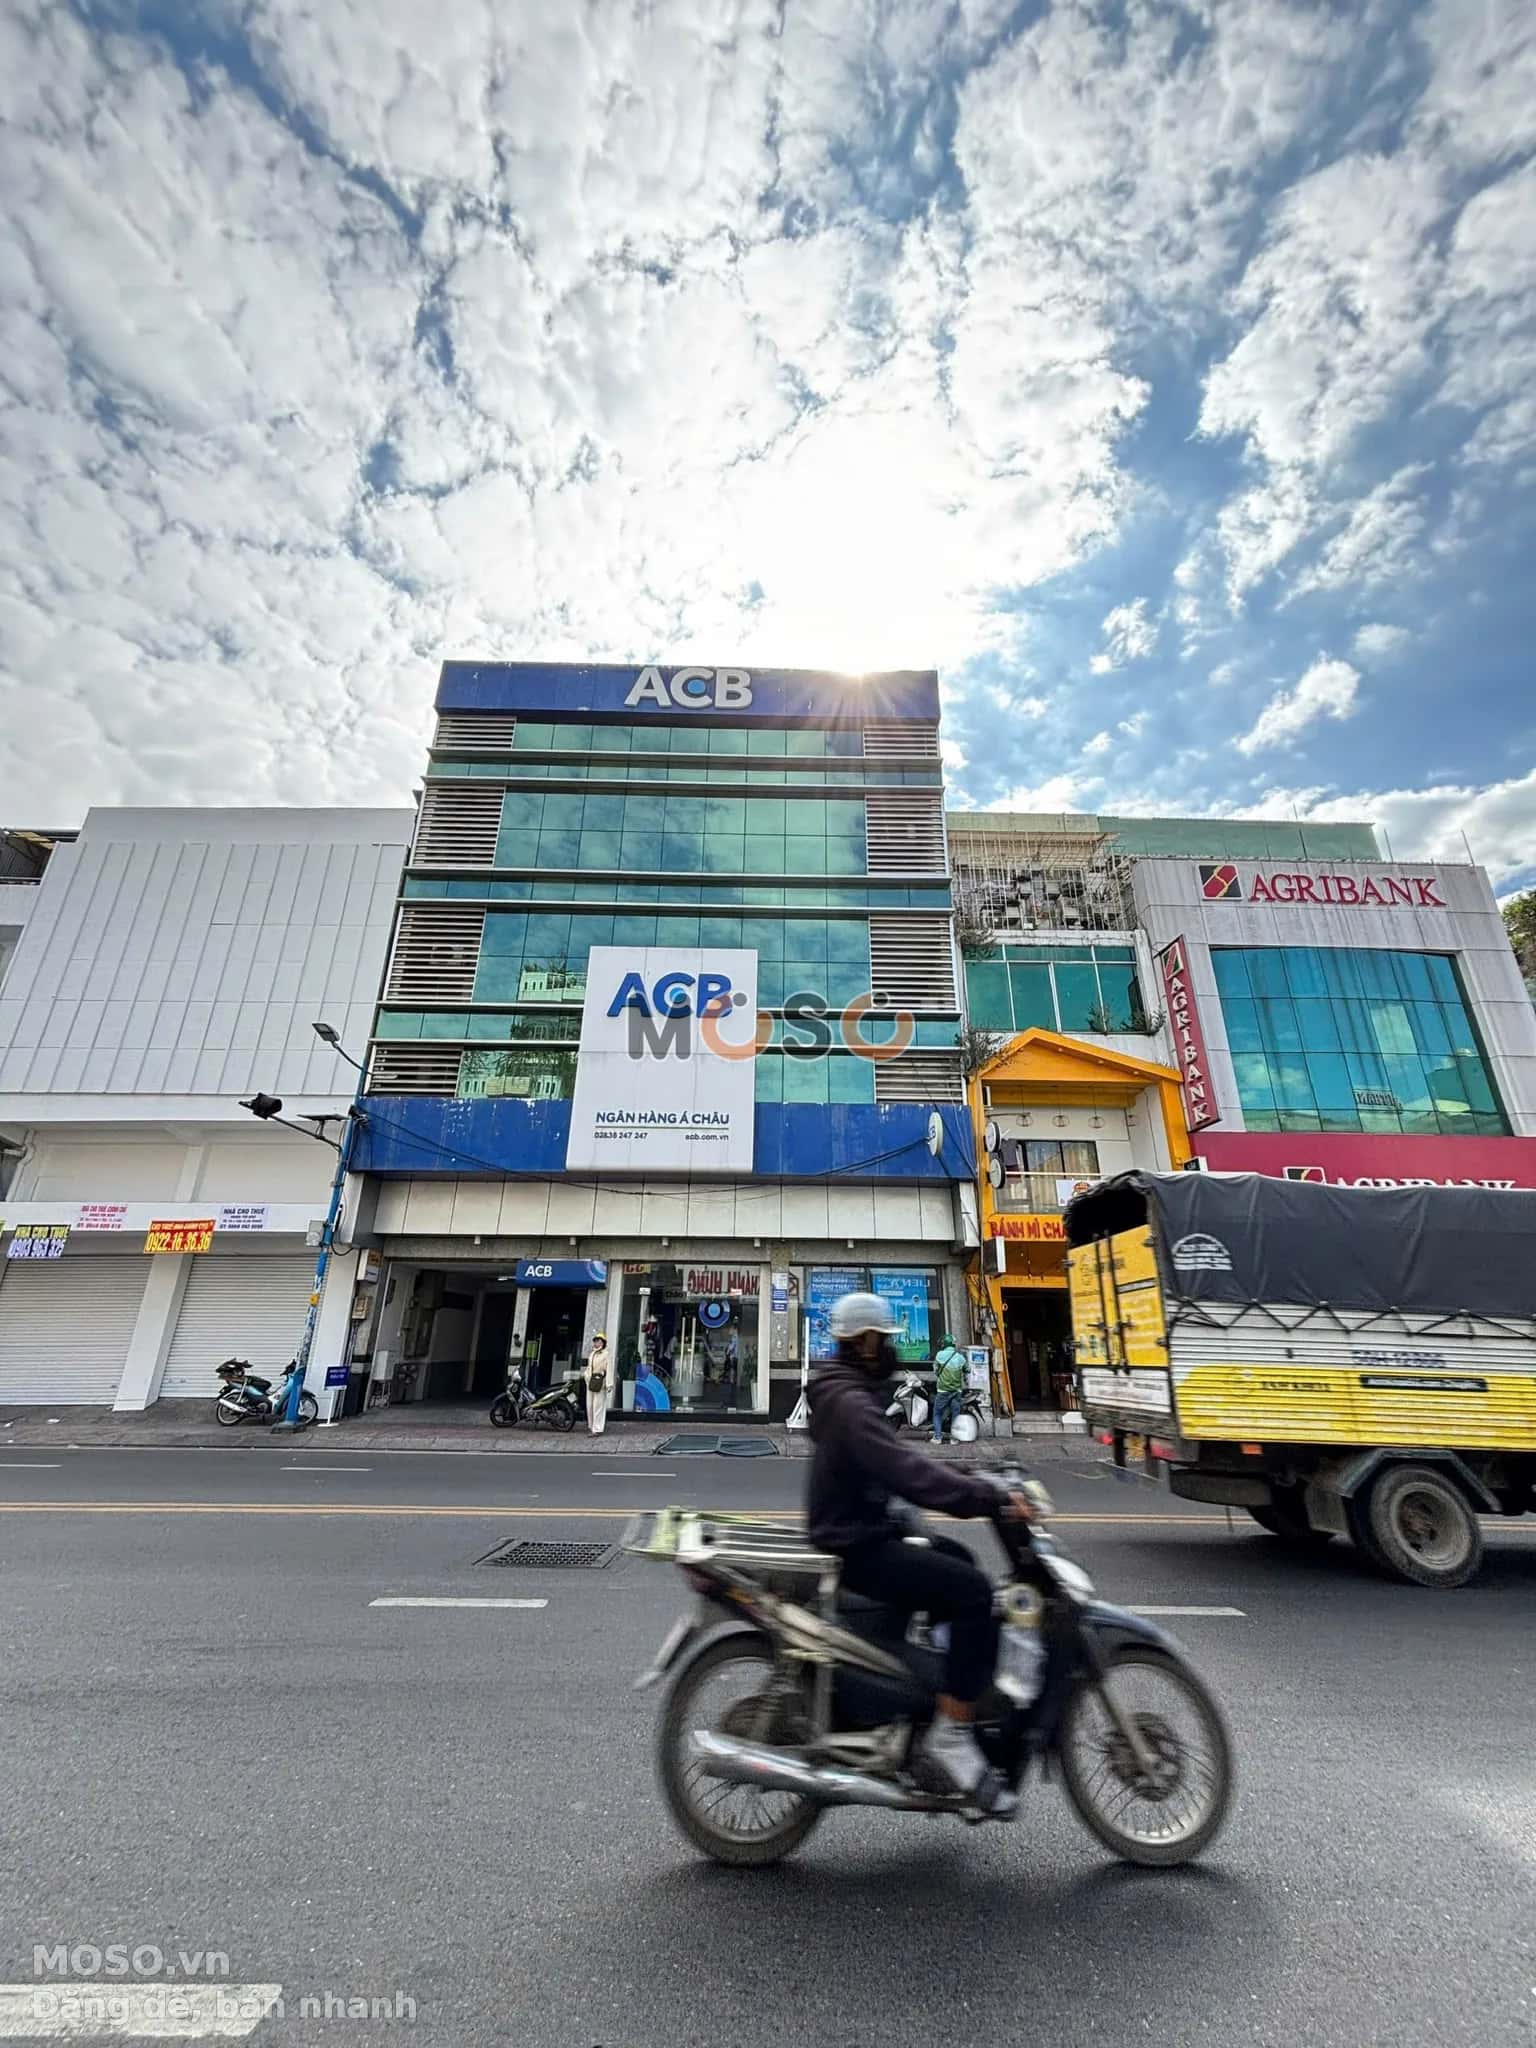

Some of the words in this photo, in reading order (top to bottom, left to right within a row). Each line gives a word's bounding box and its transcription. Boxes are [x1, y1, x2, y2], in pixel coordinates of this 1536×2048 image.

[624, 665, 753, 709] ACB
[1250, 873, 1448, 908] AGRIBANK
[606, 972, 733, 1018] ACB
[1171, 976, 1211, 1125] AGRIBANK
[595, 1110, 635, 1123] NGÂN
[638, 1110, 677, 1125] HÀNG
[679, 1111, 689, 1124] Á
[691, 1111, 730, 1125] CHÂU
[685, 1132, 729, 1141] acb.com.vn
[990, 1217, 1024, 1237] BÁNH
[524, 1265, 553, 1277] ACB
